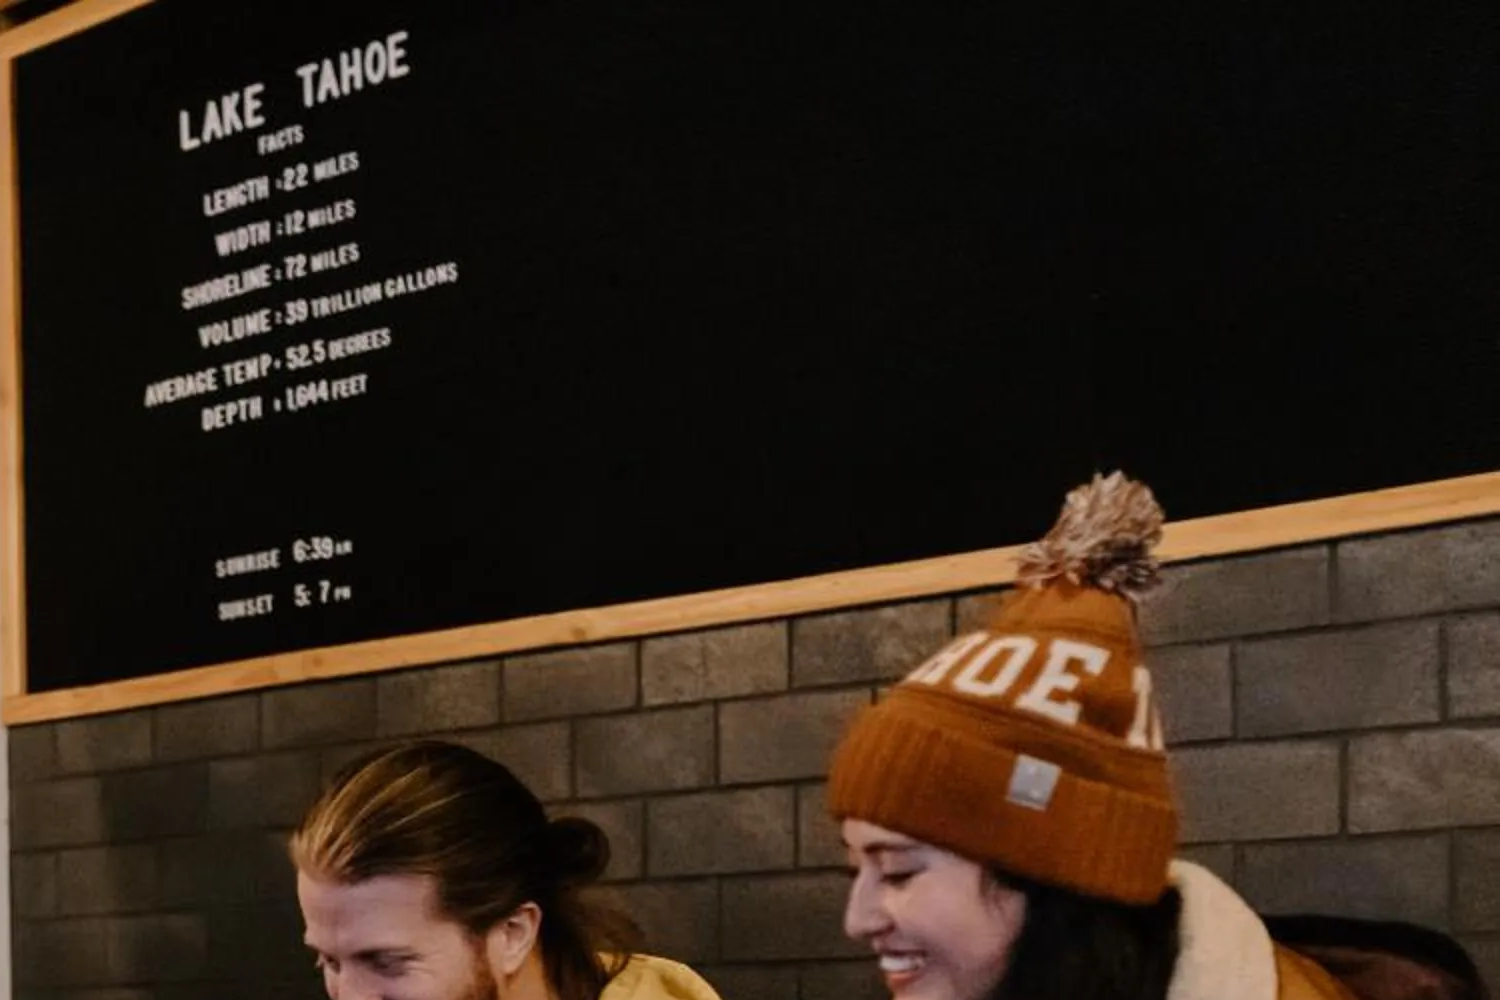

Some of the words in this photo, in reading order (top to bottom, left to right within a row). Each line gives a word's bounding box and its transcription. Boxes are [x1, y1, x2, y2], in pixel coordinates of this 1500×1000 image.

[178, 84, 265, 151] LAKE
[296, 31, 410, 107] TAHOE
[257, 125, 304, 155] FACTS
[203, 175, 270, 217] LENGTH
[313, 152, 360, 182] MILES
[215, 220, 271, 256] WIDTH
[307, 199, 356, 228] MILES
[181, 263, 272, 309] SHORELINE
[311, 242, 360, 272] MILES
[198, 308, 272, 348] VOLUME
[311, 282, 382, 318] TRILLION
[384, 262, 459, 298] GALLONS
[144, 368, 218, 407] AVERAGE
[328, 327, 392, 361] DEGREES
[201, 396, 262, 432] DEPTH
[332, 373, 368, 400] FEET
[218, 594, 274, 621] SUNSET
